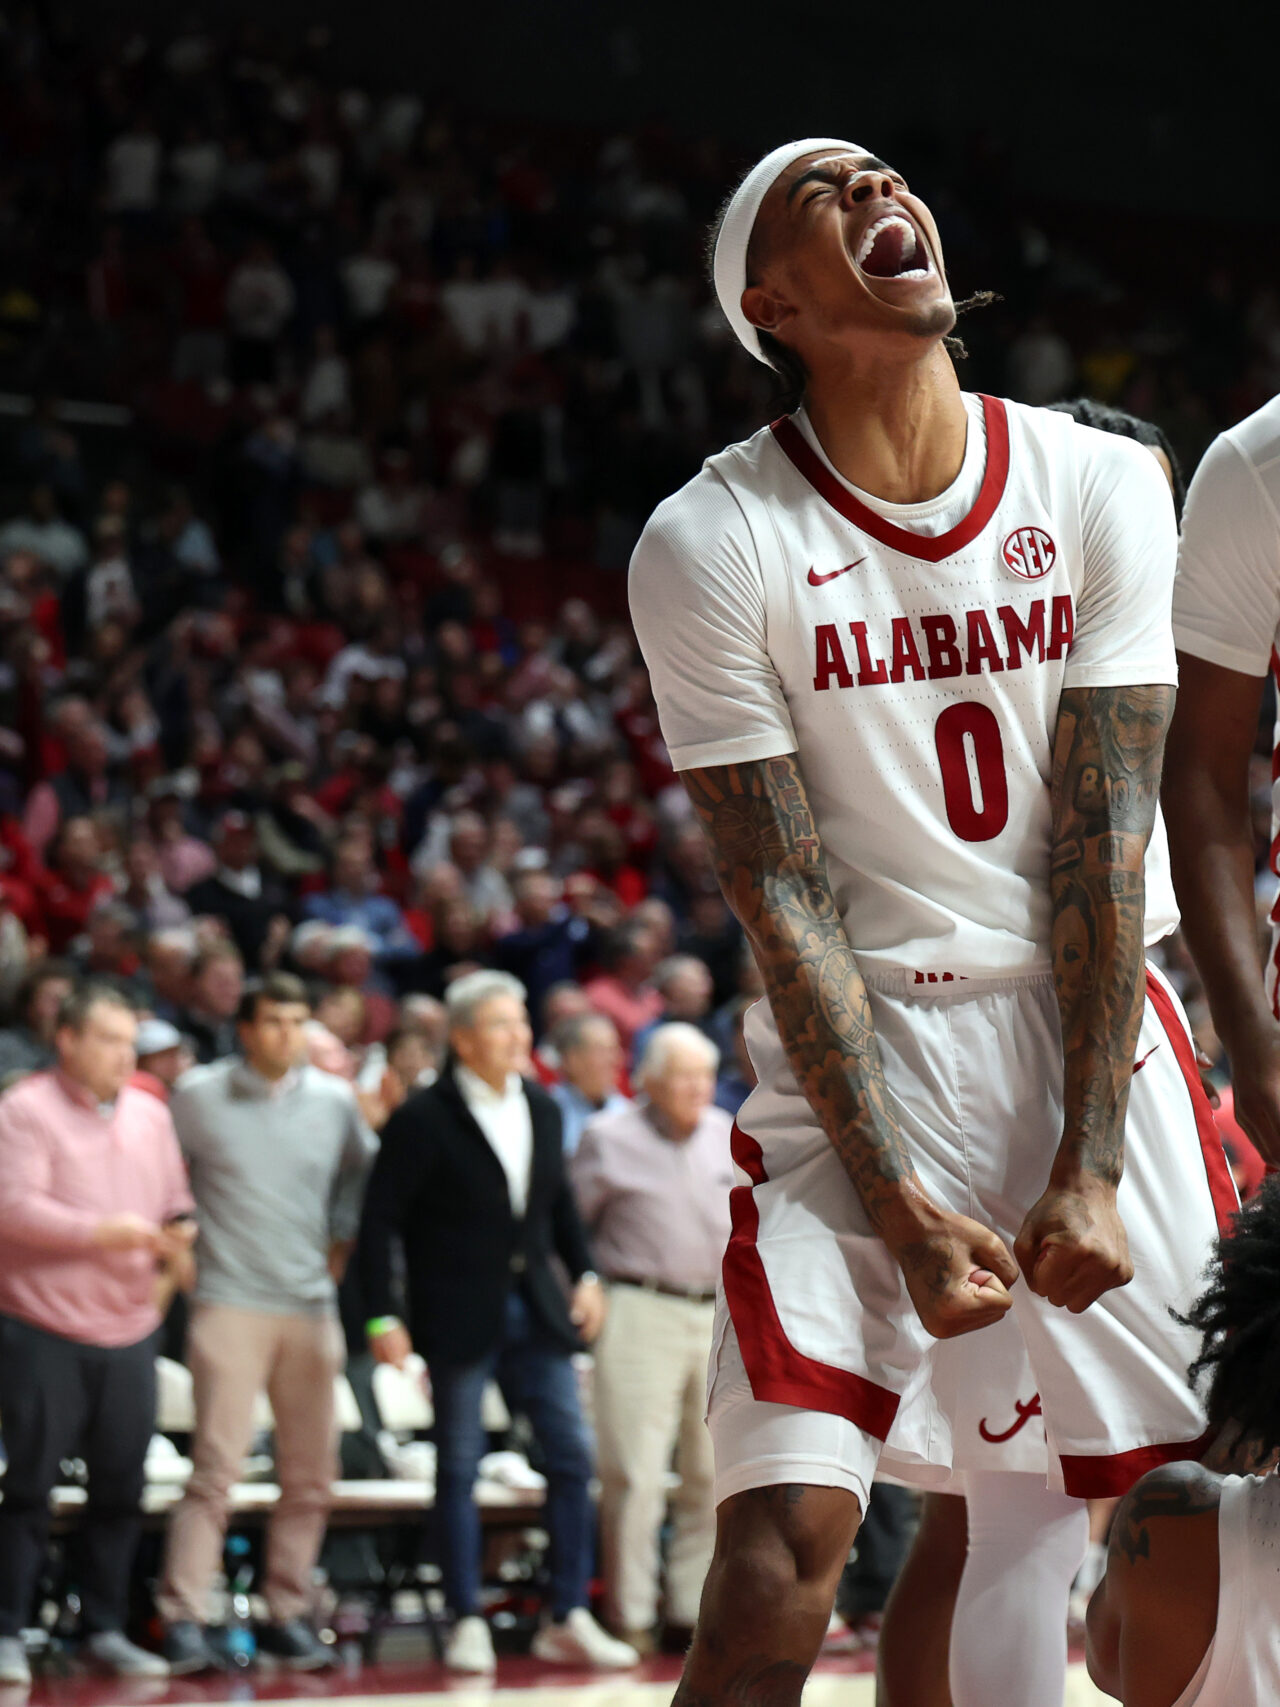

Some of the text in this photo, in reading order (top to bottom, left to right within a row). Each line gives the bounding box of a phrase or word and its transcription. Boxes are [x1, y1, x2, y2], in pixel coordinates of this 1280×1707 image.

[1004, 529, 1056, 577] SEC
[813, 594, 1074, 691] ALABAMA
[934, 701, 1009, 842] 0
